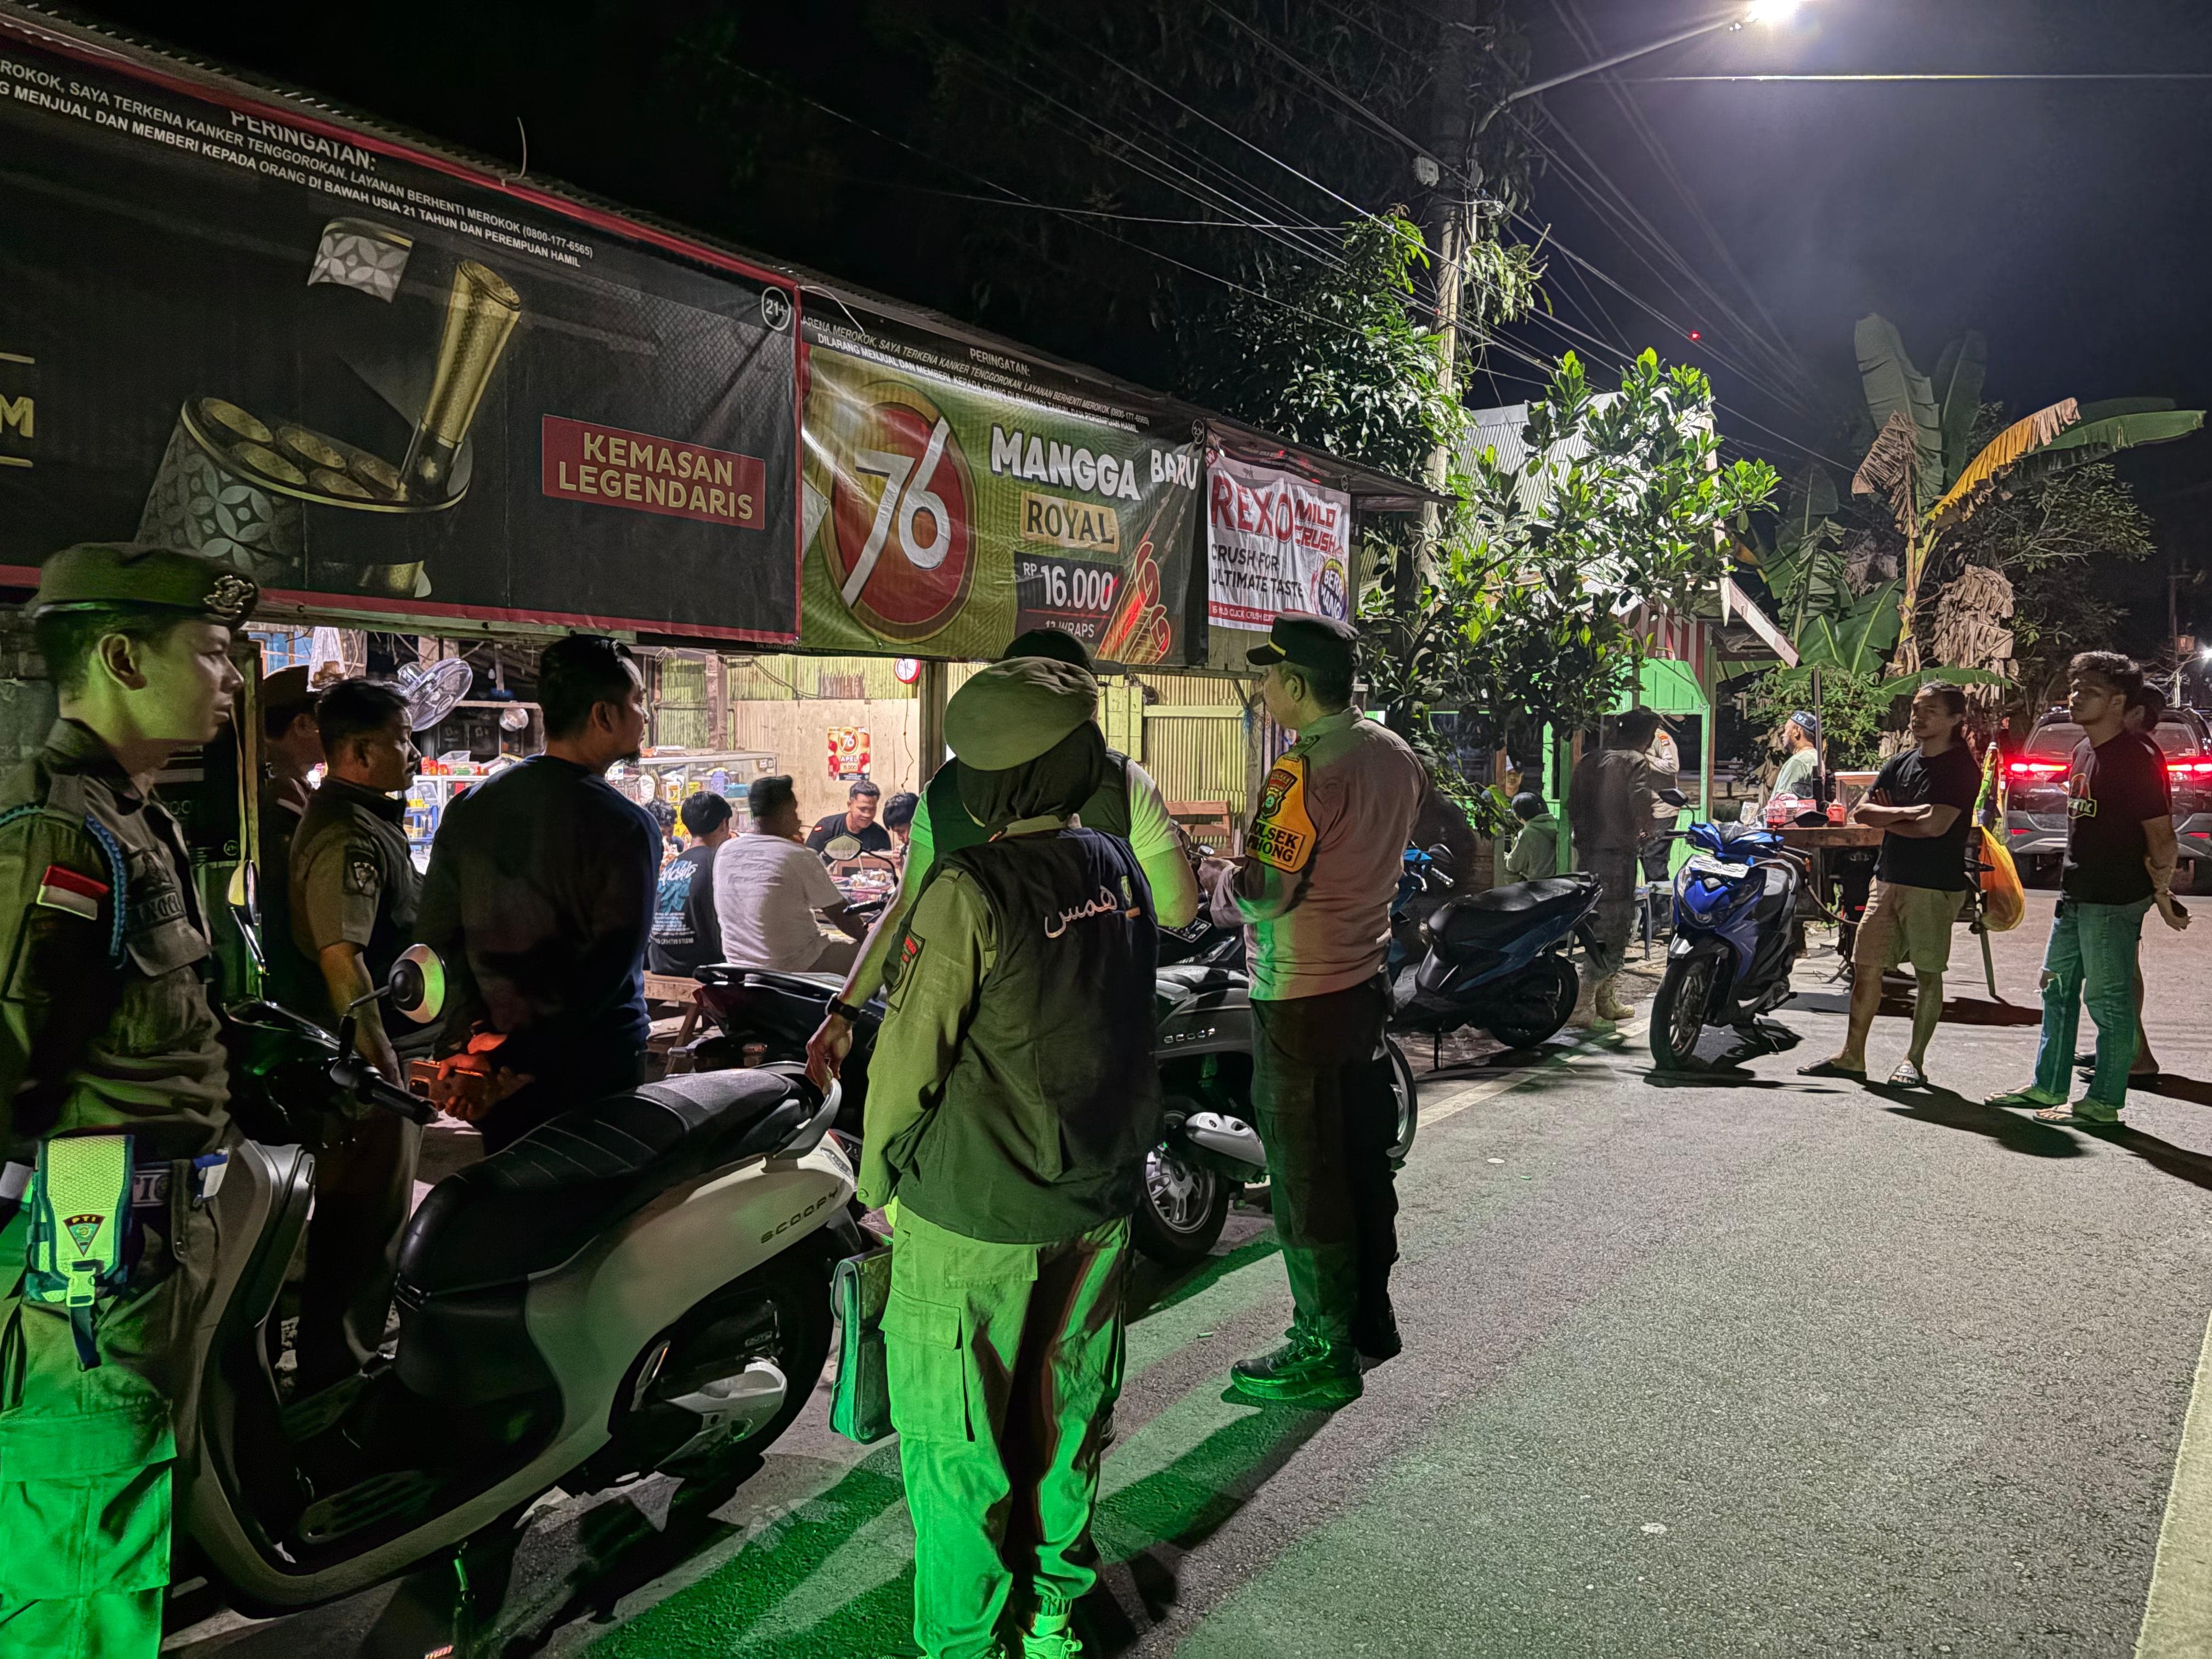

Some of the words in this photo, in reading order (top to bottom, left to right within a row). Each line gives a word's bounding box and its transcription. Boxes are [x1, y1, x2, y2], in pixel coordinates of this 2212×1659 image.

[230, 110, 376, 171] PERINGATAN:
[14, 84, 92, 121] MENJUAL
[95, 110, 128, 131] DAN
[132, 121, 199, 153] MEMBERI
[202, 144, 256, 170] KEPADA
[259, 161, 306, 184] ORANG
[308, 175, 321, 189] DI
[324, 180, 369, 204] BAWAH
[372, 195, 400, 214] USIA
[402, 205, 416, 218] 21
[419, 209, 458, 229] TAHUN
[460, 221, 483, 238] DAN
[485, 229, 549, 258] PEREMPUAN
[550, 249, 581, 268] HAMIL
[70, 82, 109, 106] SAYA
[113, 94, 183, 129] TERKENA
[186, 117, 244, 147] KANKER
[247, 137, 348, 180] TENGGOROKAN.
[350, 171, 404, 198] LAYANAN
[407, 189, 465, 216] BERHENTI
[467, 207, 521, 234] MEROKOK
[523, 224, 593, 258] (0800-177-6565)
[765, 299, 787, 317] 21+
[800, 315, 831, 332] ARENA
[833, 325, 878, 347] MEROKOK,
[879, 339, 901, 354] SAYA
[903, 346, 938, 365] TERKENA
[939, 358, 970, 374] KANKER
[970, 366, 1023, 391] TENGGOROKAN.
[1023, 383, 1053, 397] LAYANAN
[1052, 391, 1082, 407] BERHENTI
[1081, 399, 1111, 415] MEROKOK
[1110, 407, 1150, 426] (0800-177-6565)
[817, 332, 860, 355] DILARANG
[861, 347, 899, 367] MENJUAL
[899, 360, 916, 373] DAN
[916, 364, 951, 382] MEMBERI
[953, 375, 982, 391] KEPADA
[982, 383, 1007, 398] ORANG
[1007, 390, 1015, 400] DI
[969, 347, 1031, 377] PERINGATAN:
[583, 432, 733, 487] KEMASAN
[991, 425, 1142, 501] MANGGA
[1150, 449, 1198, 490] BARU
[558, 461, 753, 521] LEGENDARIS
[841, 416, 951, 608] 76
[1211, 475, 1294, 543] REXO
[1295, 499, 1336, 530] MILD
[1026, 500, 1116, 545] ROYAL
[1294, 525, 1335, 556] CRUSH
[1211, 544, 1256, 567] CRUSH
[1259, 552, 1279, 571] FOR
[1211, 568, 1268, 593] ULTIMATE
[1271, 578, 1304, 598] TASTE
[1023, 562, 1037, 576] RP
[1040, 565, 1114, 611] 16.000
[1229, 608, 1245, 619] CLICK
[1246, 611, 1262, 622] CRUSH
[841, 731, 855, 751] 76
[1251, 822, 1299, 849] OLSEK
[1045, 885, 1118, 938] همس
[760, 1186, 838, 1244] SCOOPY
